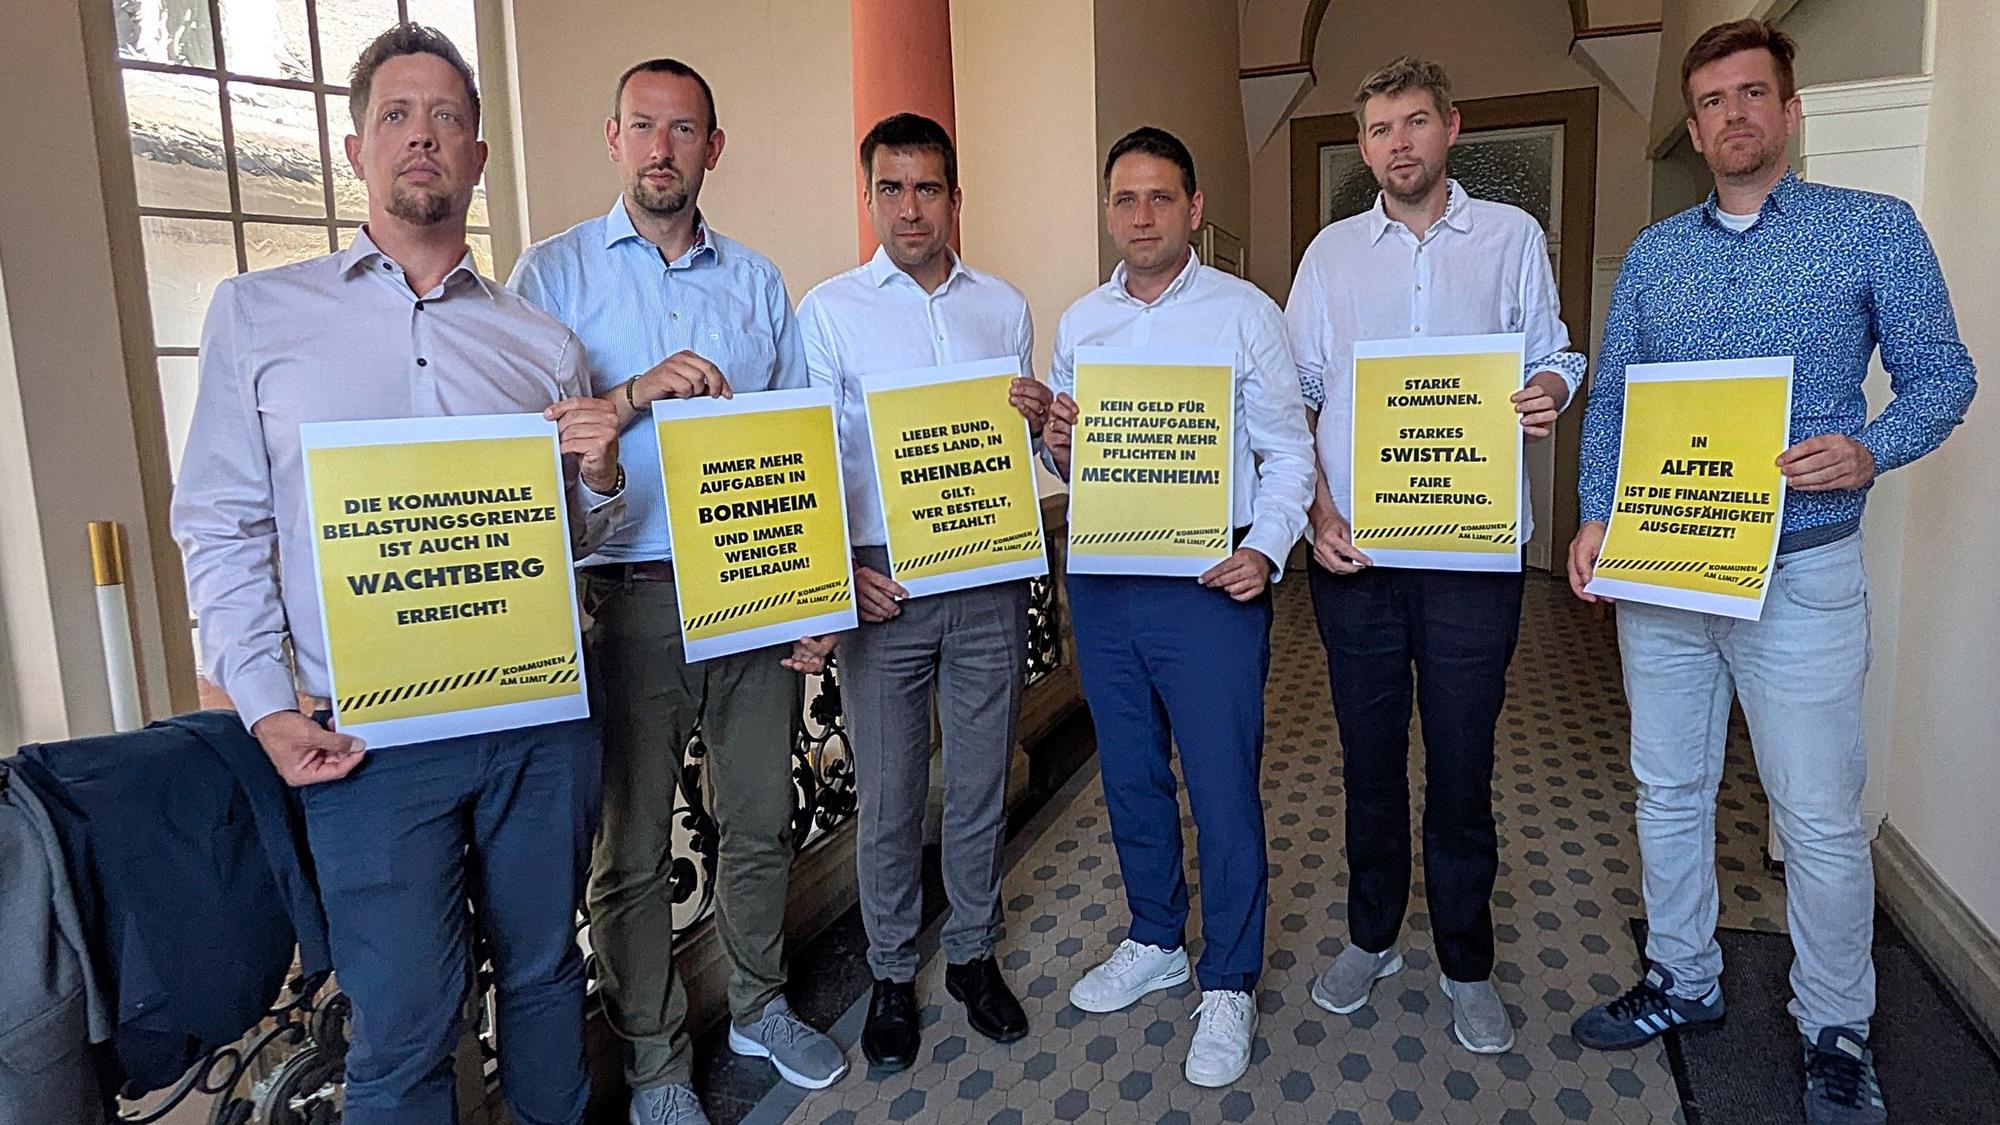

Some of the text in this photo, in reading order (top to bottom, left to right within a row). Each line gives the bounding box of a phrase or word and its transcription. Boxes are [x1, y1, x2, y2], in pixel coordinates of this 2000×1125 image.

[1405, 378, 1460, 390] STARKE
[1101, 401, 1205, 412] KEIN GELD FÜR
[1387, 394, 1482, 407] KOMMUNEN.
[902, 420, 994, 441] LIEBER BUND,
[1085, 417, 1220, 430] PFLICHTAUFGABEN,
[1086, 433, 1217, 445] ABER IMMER MEHR
[1400, 428, 1463, 439] STARKES
[1691, 436, 1707, 448] IN
[895, 434, 1002, 459] LIEBES LAND, IN
[1103, 449, 1195, 460] PFLICHTEN IN
[1380, 448, 1487, 462] SWISTTAL.
[703, 453, 803, 475] IMMER MEHR
[900, 456, 1011, 485] RHEINBACH
[1661, 460, 1733, 477] ALFTER
[700, 471, 805, 494] AUFGABEN IN
[1081, 468, 1219, 485] MECKENHEIM!
[1410, 477, 1451, 487] FAIRE
[345, 487, 533, 515] DIE KOMMUNALE
[941, 487, 975, 500] GILT:
[1375, 493, 1492, 505] FINANZIERUNG.
[1625, 486, 1770, 504] IST DIE FINANZIELLE
[698, 494, 817, 524] BORNHEIM
[912, 497, 1011, 520] WER BESTELLT,
[1617, 502, 1774, 523] LEISTUNGSFÄHIGKEIT
[322, 507, 556, 540] BELASTUNGSGRENZE
[932, 514, 996, 533] BEZAHLT!
[1176, 528, 1219, 536] KOMMUNEN
[1461, 523, 1507, 531] KOMMUNEN
[1639, 521, 1736, 539] AUSGEREIZT!
[714, 524, 803, 547] UND IMMER
[993, 531, 1032, 545] KOMMUNEN
[380, 533, 510, 557] IST AUCH IN
[725, 542, 797, 563] WENIGER
[347, 558, 544, 595] WACHTBERG
[720, 558, 810, 583] SPIELRAUM!
[1718, 574, 1739, 583] LIMIT
[798, 580, 841, 597] KOMMUNEN
[797, 595, 829, 605] AM LIMIT
[397, 600, 508, 625] ERREICHT!
[502, 656, 565, 676] KOMMUNEN
[500, 674, 548, 685] AM LIMIT
